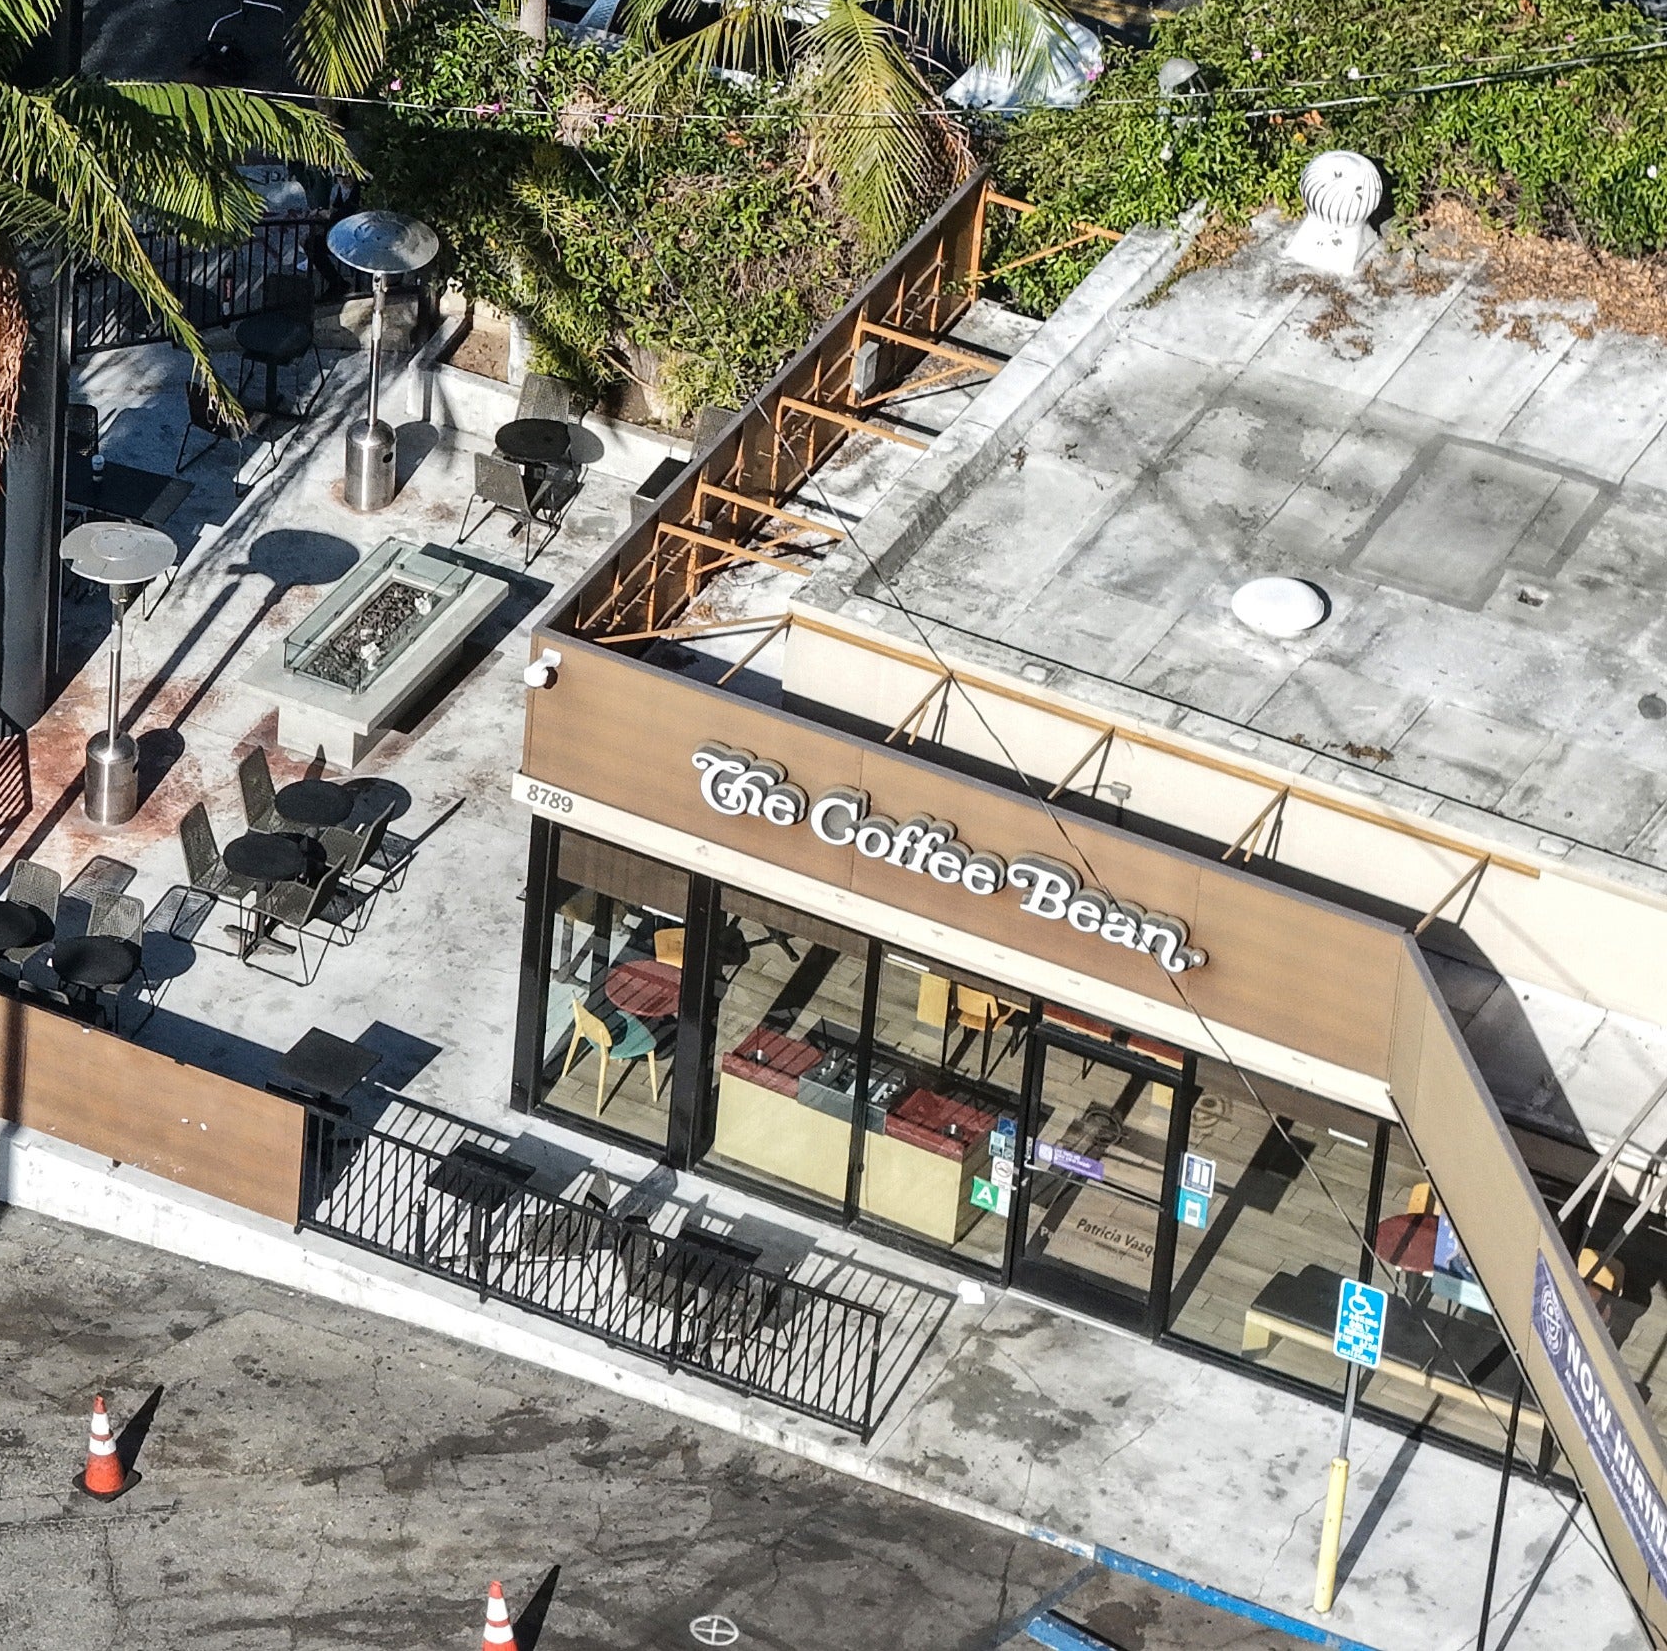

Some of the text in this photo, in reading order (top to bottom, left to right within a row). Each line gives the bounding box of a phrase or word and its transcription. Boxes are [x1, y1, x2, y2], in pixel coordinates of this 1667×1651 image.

[525, 783, 575, 814] 8789
[690, 749, 1191, 974] The Coffee Bean
[976, 1185, 994, 1206] A
[1076, 1217, 1123, 1244] Patricia
[1567, 1331, 1612, 1435] NOW
[1613, 1429, 1667, 1561] HIRIN
